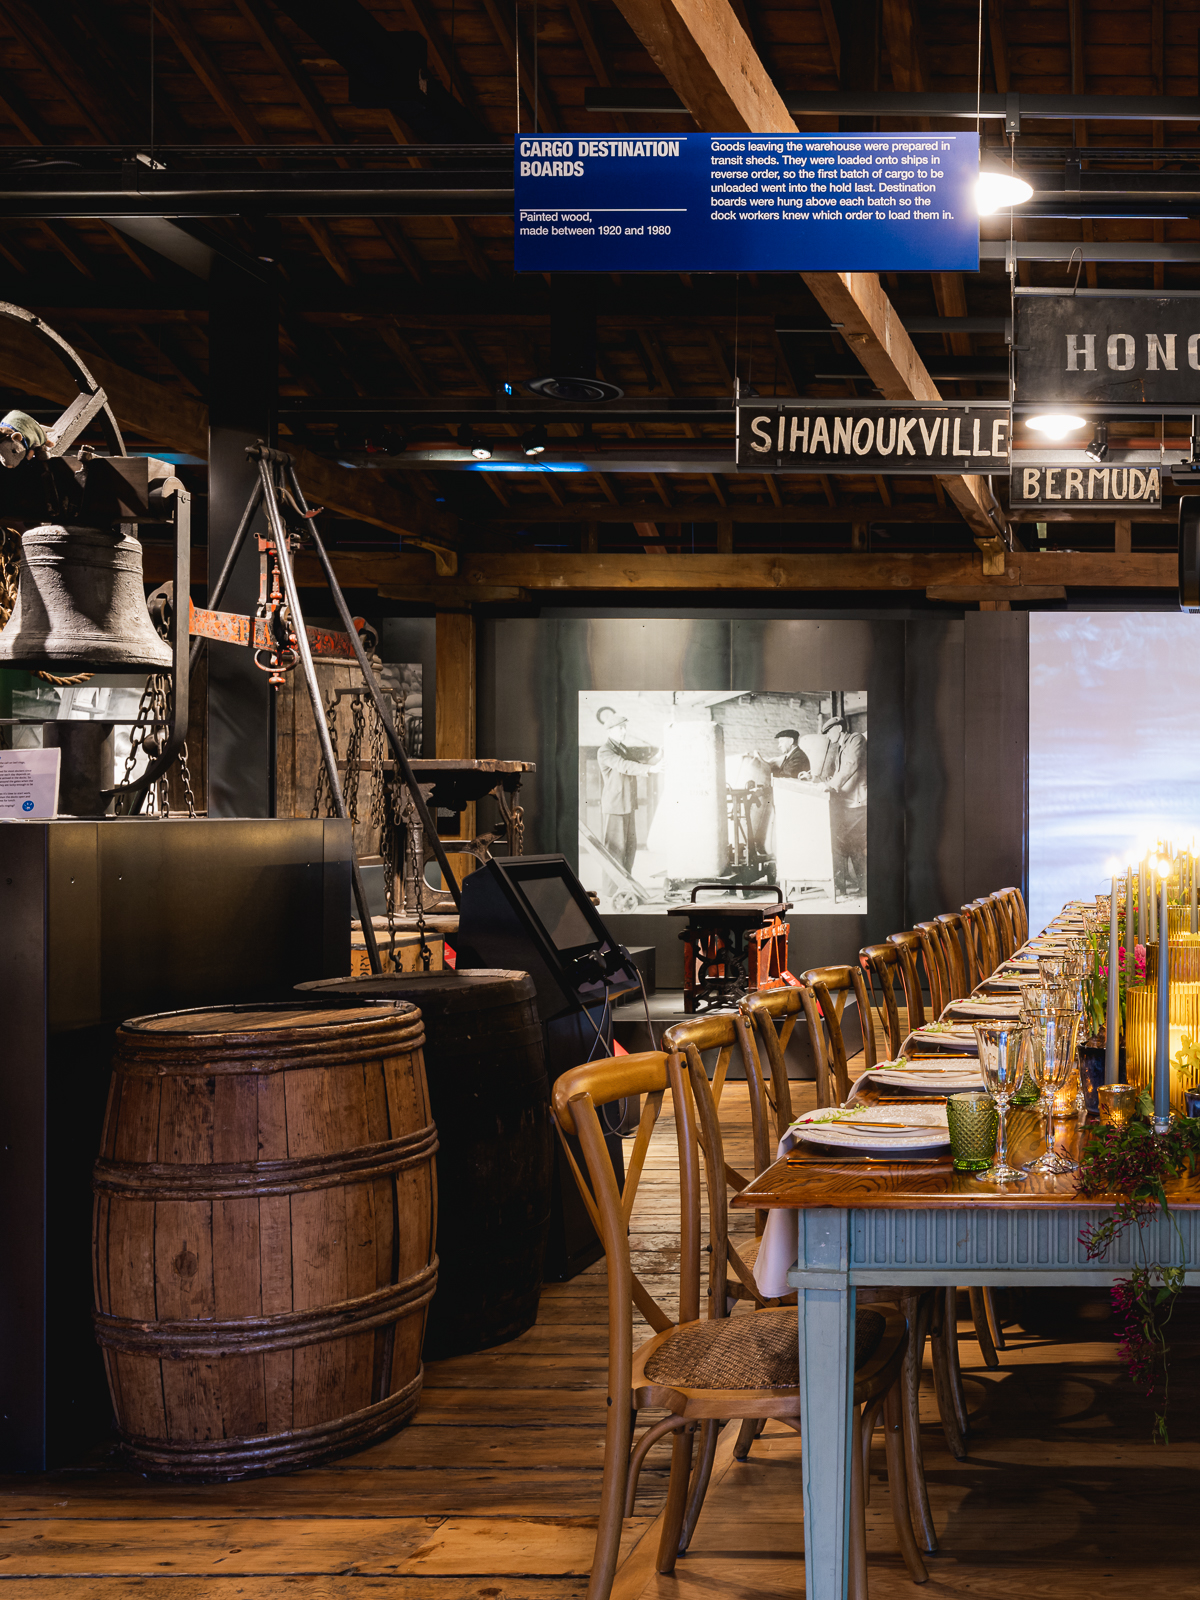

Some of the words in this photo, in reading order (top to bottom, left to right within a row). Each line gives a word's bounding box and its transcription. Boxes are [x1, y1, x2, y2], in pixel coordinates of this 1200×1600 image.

[519, 141, 574, 157] CARGO
[578, 141, 680, 157] DESTINATION
[710, 141, 746, 151] Goods
[747, 141, 785, 153] leaving
[785, 141, 804, 151] the
[804, 141, 862, 151] warehouse
[863, 143, 890, 151] were
[891, 141, 939, 153] prepared
[940, 141, 951, 150] in
[710, 155, 744, 165] transit
[744, 155, 780, 165] sheds.
[781, 155, 808, 167] They
[808, 157, 836, 165] were
[836, 155, 873, 165] loaded
[874, 155, 899, 164] onto
[900, 155, 929, 166] ships
[930, 155, 941, 164] in
[520, 161, 585, 176] BOARDS
[710, 171, 749, 179] reverse
[750, 169, 781, 181] order,
[797, 169, 816, 178] the
[816, 169, 839, 179] first
[839, 169, 870, 179] batch
[871, 169, 884, 178] of
[884, 171, 916, 182] cargo
[916, 169, 929, 178] to
[930, 169, 945, 178] be
[710, 183, 759, 192] unloaded
[760, 183, 787, 192] went
[788, 183, 809, 192] into
[809, 183, 828, 192] the
[828, 182, 853, 192] hold
[853, 182, 877, 192] last.
[878, 182, 937, 192] Destination
[710, 197, 748, 206] boards
[776, 197, 804, 208] hung
[804, 196, 838, 206] above
[838, 196, 865, 206] each
[866, 196, 897, 206] batch
[898, 198, 913, 206] so
[913, 196, 932, 206] the
[519, 212, 559, 221] Painted
[560, 212, 593, 223] wood,
[710, 210, 737, 220] dock
[738, 210, 781, 220] workers
[781, 210, 811, 220] knew
[811, 210, 843, 220] which
[844, 210, 874, 220] order
[874, 210, 887, 220] to
[887, 210, 911, 220] load
[912, 210, 940, 220] them
[941, 210, 955, 219] in.
[519, 226, 549, 235] made
[551, 226, 596, 235] between
[597, 226, 623, 235] 1920
[623, 226, 645, 235] and
[646, 226, 672, 235] 1980
[750, 415, 1010, 458] SIHANOUKVILLE
[1022, 467, 1161, 500] BERMUDA
